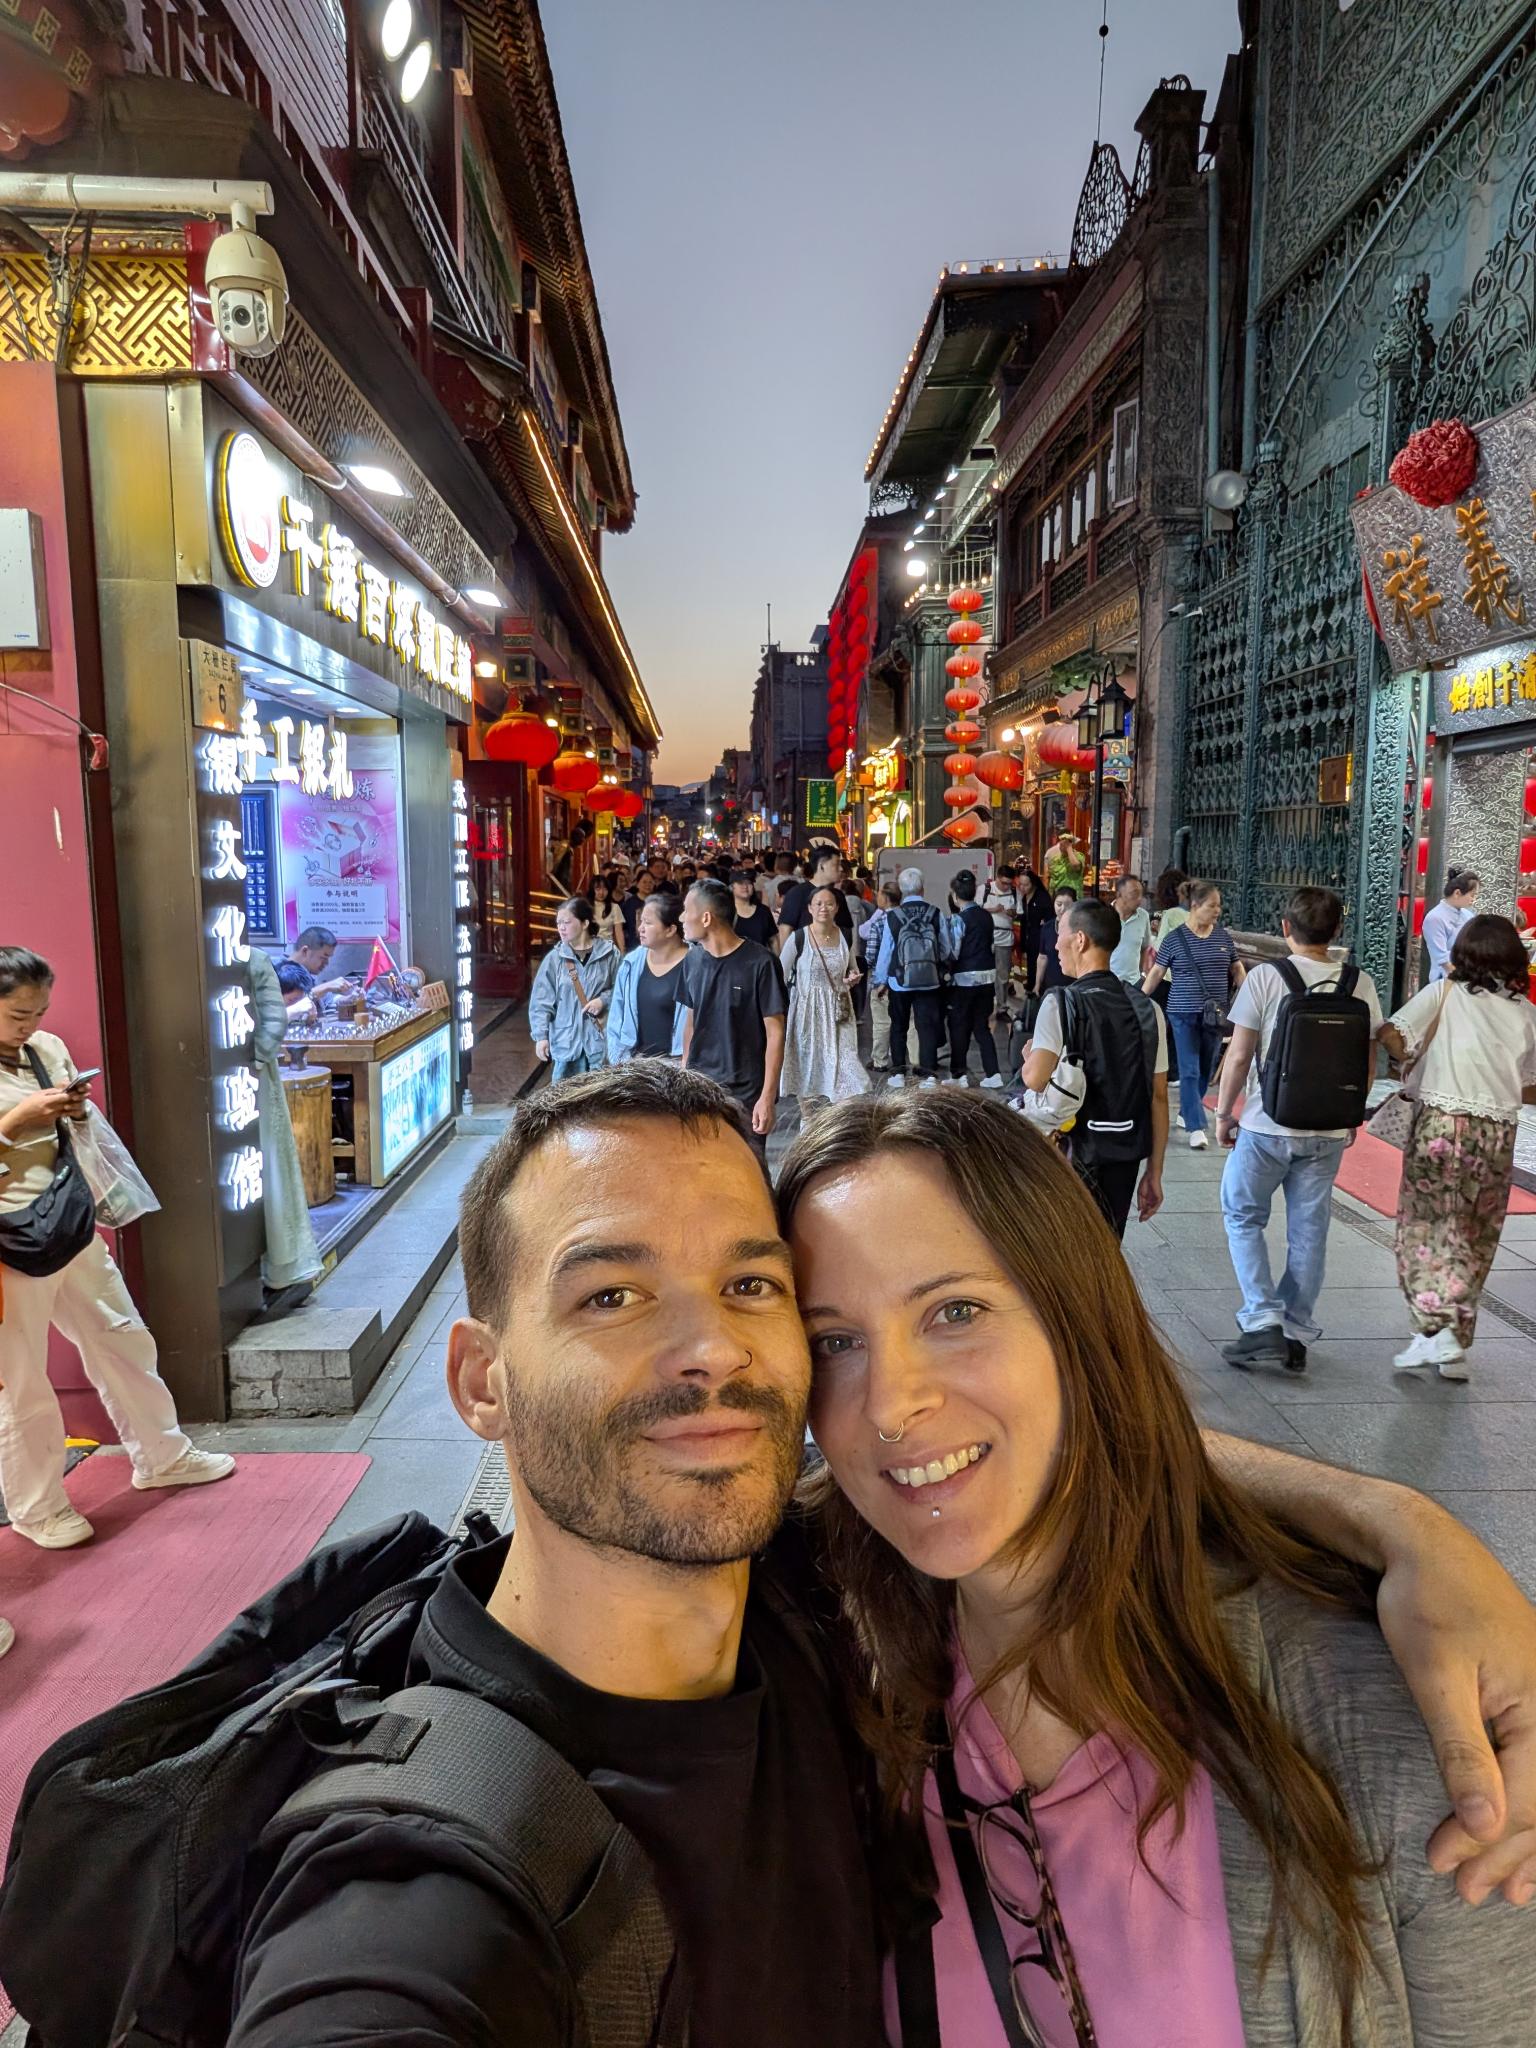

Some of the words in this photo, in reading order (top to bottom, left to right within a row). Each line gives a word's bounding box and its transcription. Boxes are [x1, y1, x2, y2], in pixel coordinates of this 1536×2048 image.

[1383, 490, 1536, 644] 祥義
[218, 683, 227, 714] 6
[201, 734, 265, 1211] 银文化体验馆
